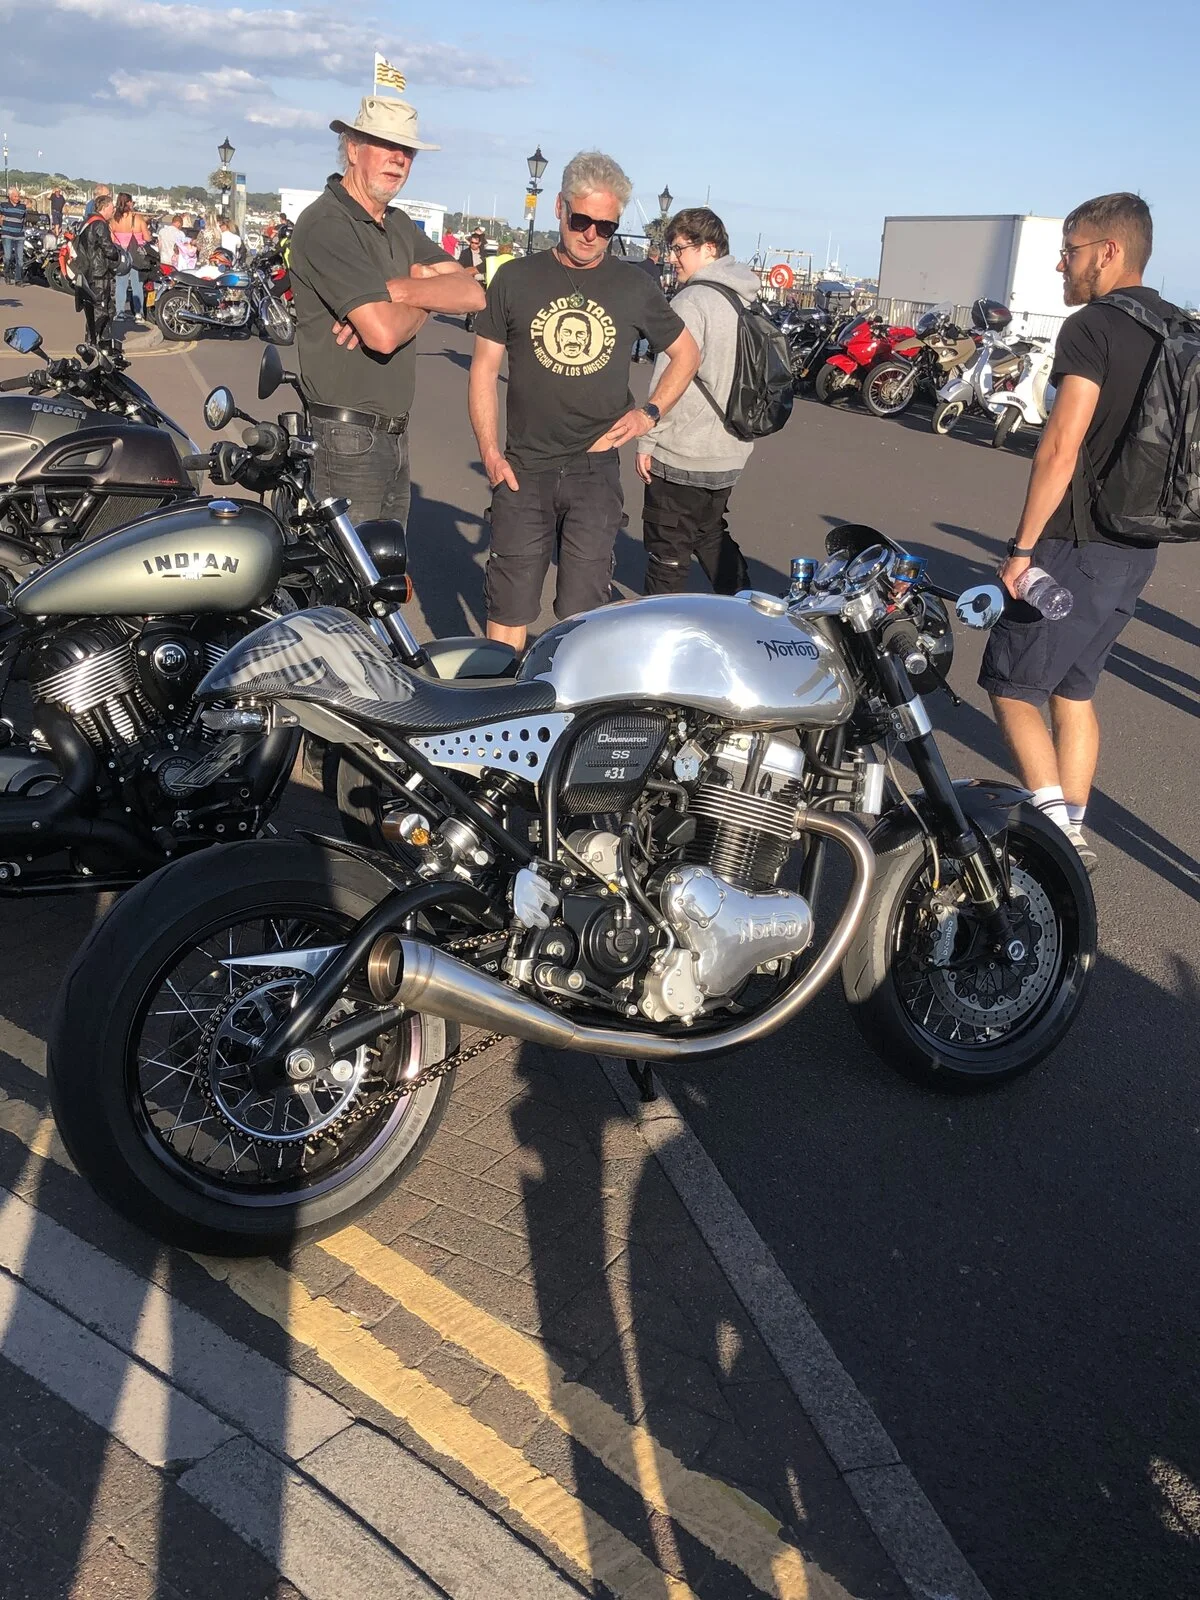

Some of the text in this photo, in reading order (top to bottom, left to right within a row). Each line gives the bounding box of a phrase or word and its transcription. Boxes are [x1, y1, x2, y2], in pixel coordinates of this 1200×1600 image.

[530, 297, 616, 348] TREJO' TACOS
[534, 346, 611, 377] HECHO EN LOS ANGELES
[31, 402, 87, 420] DUCATI
[142, 552, 240, 575] INDIAN
[162, 654, 181, 665] 1901
[757, 640, 820, 661] Norton
[611, 750, 631, 759] SS
[604, 767, 625, 779] #31
[735, 912, 802, 944] Norton
[941, 920, 954, 956] brembo
